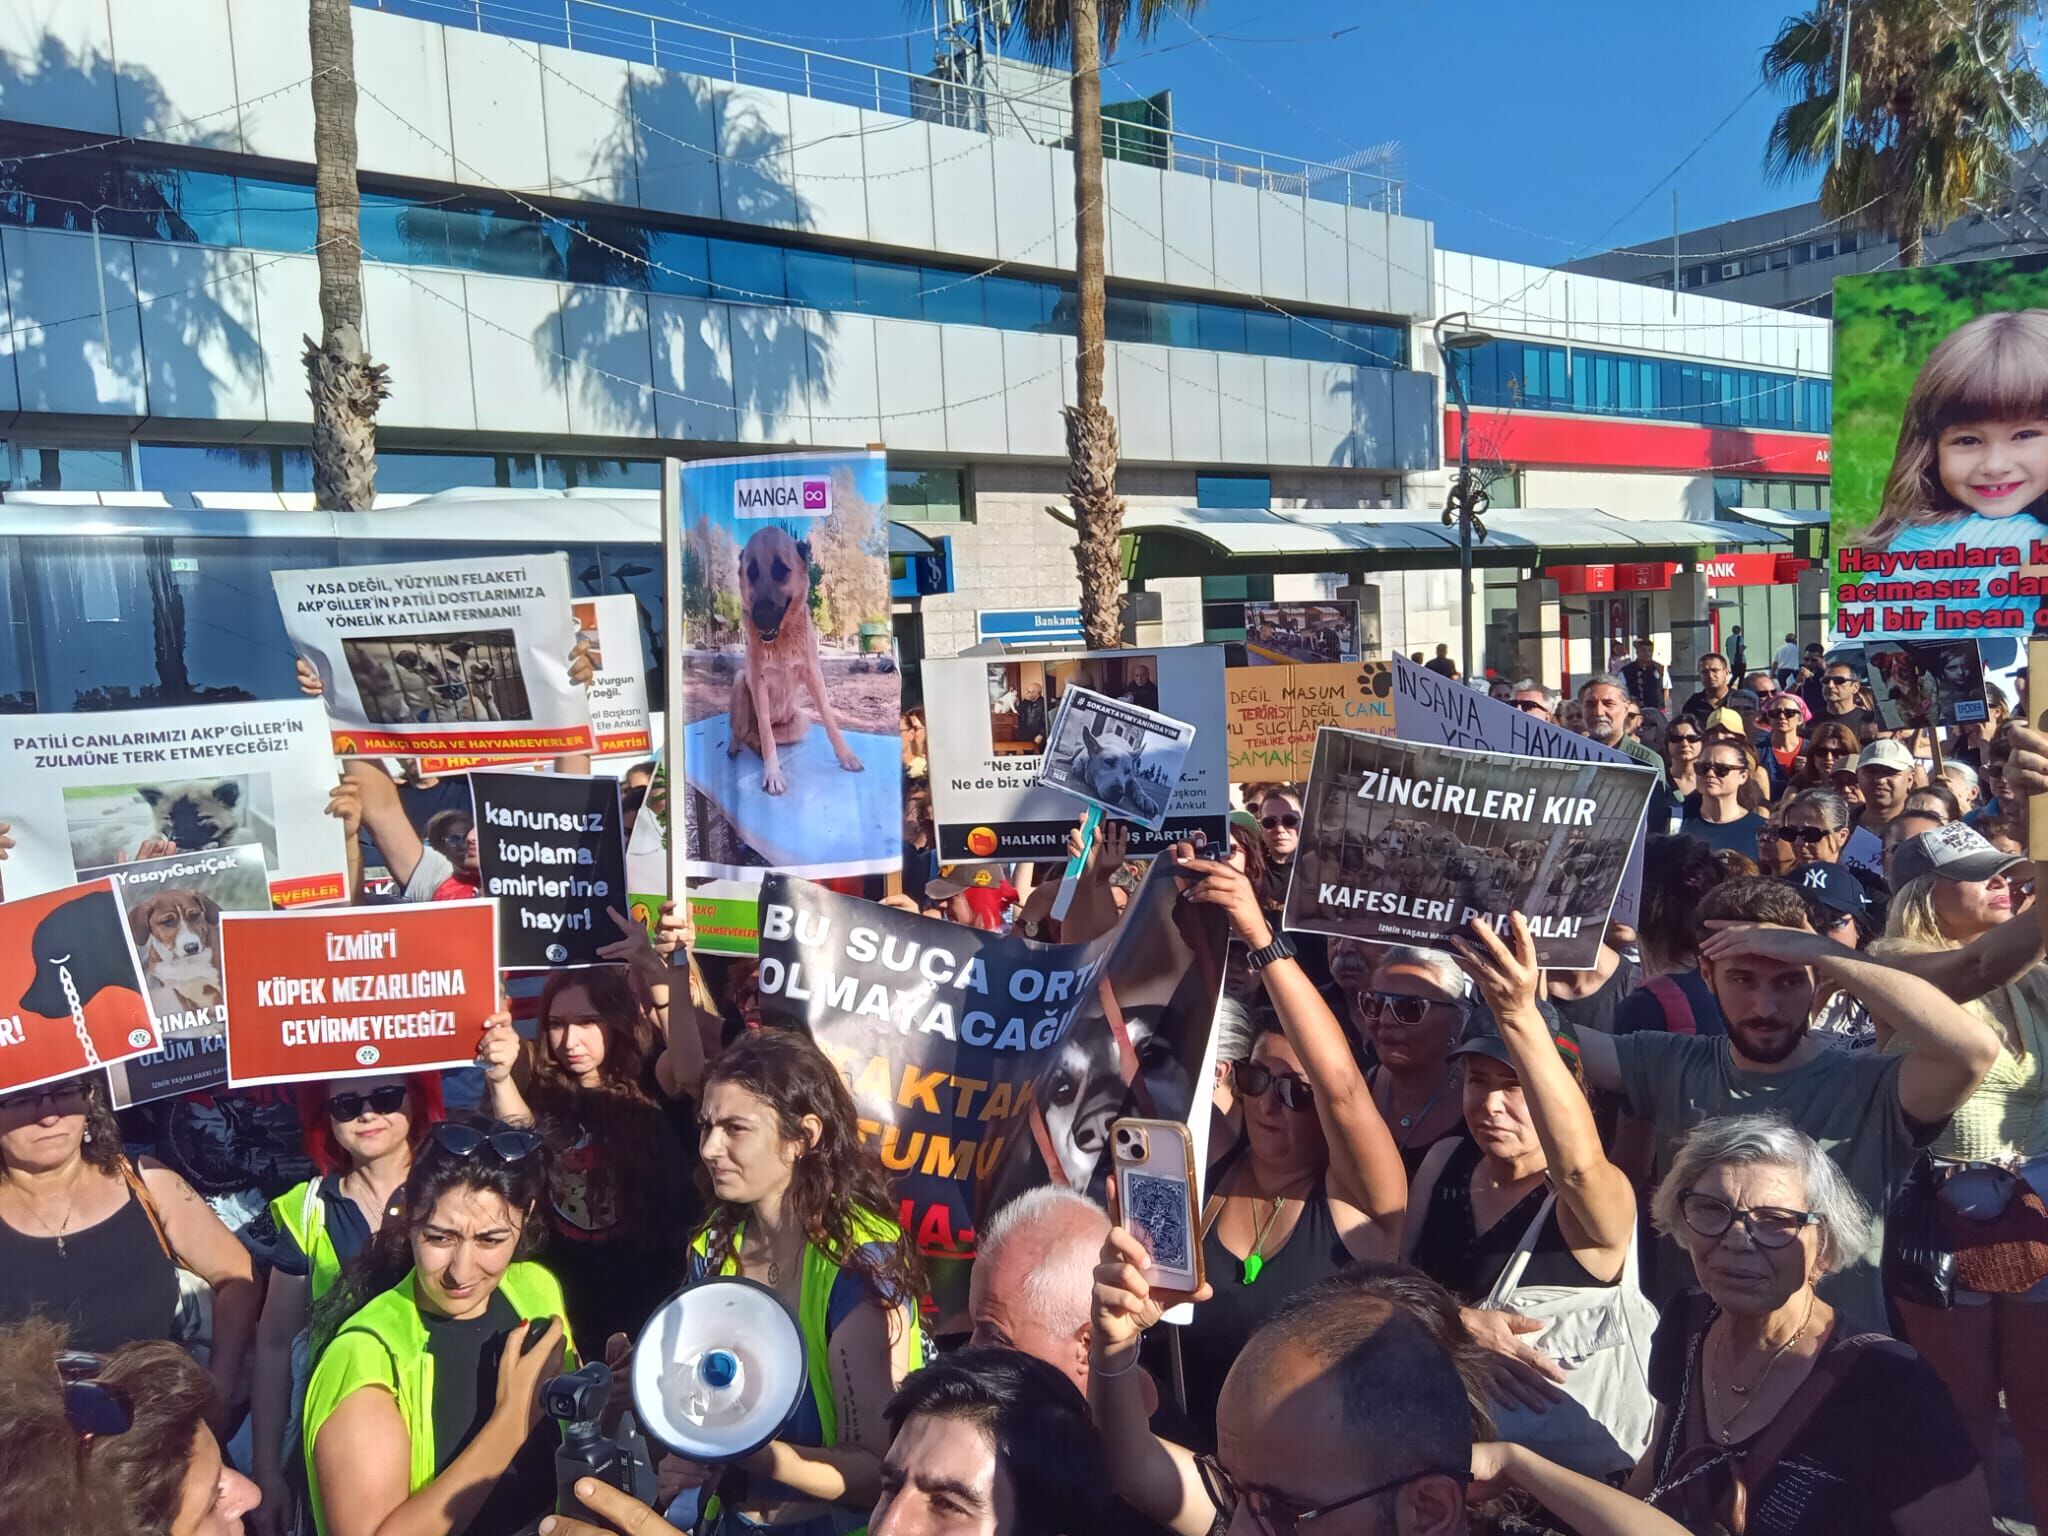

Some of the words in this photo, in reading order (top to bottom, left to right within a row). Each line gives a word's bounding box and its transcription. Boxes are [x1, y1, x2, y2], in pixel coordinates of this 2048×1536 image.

[737, 487, 798, 508] MANGA
[1838, 543, 2021, 577] Hayvanlara
[306, 583, 346, 595] YASA
[349, 577, 392, 594] DEĞİL,
[396, 572, 460, 590] YÜZYILIN
[462, 566, 527, 584] FELAKETİ
[1838, 578, 1980, 602] acımasız
[393, 593, 436, 607] PATİLİ
[439, 589, 546, 604] DOSTLARIMIZA
[326, 614, 385, 629] YÖNELİK
[388, 609, 451, 625] KATLİAM
[453, 605, 521, 621] FERMANI!
[1837, 607, 1874, 638] iyi
[1883, 605, 1928, 632] bir
[1934, 605, 2024, 630] insan
[598, 675, 634, 688] Vurgun
[593, 689, 621, 699] Değil.
[1231, 687, 1271, 704] DEĞİL
[1282, 685, 1345, 700] MASUM
[1397, 660, 1483, 737] İNSANA
[603, 708, 641, 722] Başkanı
[1302, 703, 1340, 718] DEĞİL
[597, 721, 612, 730] Efe
[614, 718, 642, 729] Ankut
[14, 736, 69, 749] PATİLİ
[72, 730, 186, 748] CANLARIMIZI
[365, 739, 408, 751] HALKÇI
[411, 738, 447, 750] DOĞA
[450, 739, 466, 749] VE
[468, 736, 584, 749] HAYVANSEVERLER
[602, 736, 647, 750] PARTİSİ
[34, 751, 121, 768] ZULMÜNE
[125, 749, 166, 762] TERK
[170, 741, 289, 760] ETMEYECEĞİZ!
[952, 780, 971, 790] Ne
[975, 778, 994, 789] de
[997, 777, 1019, 788] biz
[1175, 802, 1206, 810] Ankut
[1357, 768, 1537, 823] ZİNCİRLERİ
[1541, 796, 1597, 826] KIR
[485, 802, 604, 833] kanunsuz
[1001, 834, 1056, 846] HALKIN
[1145, 827, 1202, 842] PARTİS
[499, 842, 592, 866] toplama
[489, 876, 609, 898] emirlerine
[520, 908, 591, 933] hayır!
[1318, 883, 1455, 922] KAFESLERİ
[1460, 906, 1582, 939] PARALA!
[326, 928, 398, 962] İZMİR'İ
[763, 904, 831, 948] BU
[846, 927, 989, 995] SUÇA
[257, 976, 326, 1007] KÖPEK
[332, 968, 465, 1003] MEZARLIĞINA
[758, 957, 1080, 1051] OLMAYACAĞI
[282, 1009, 456, 1047] ÇEVİRMEYECEĞİZ!
